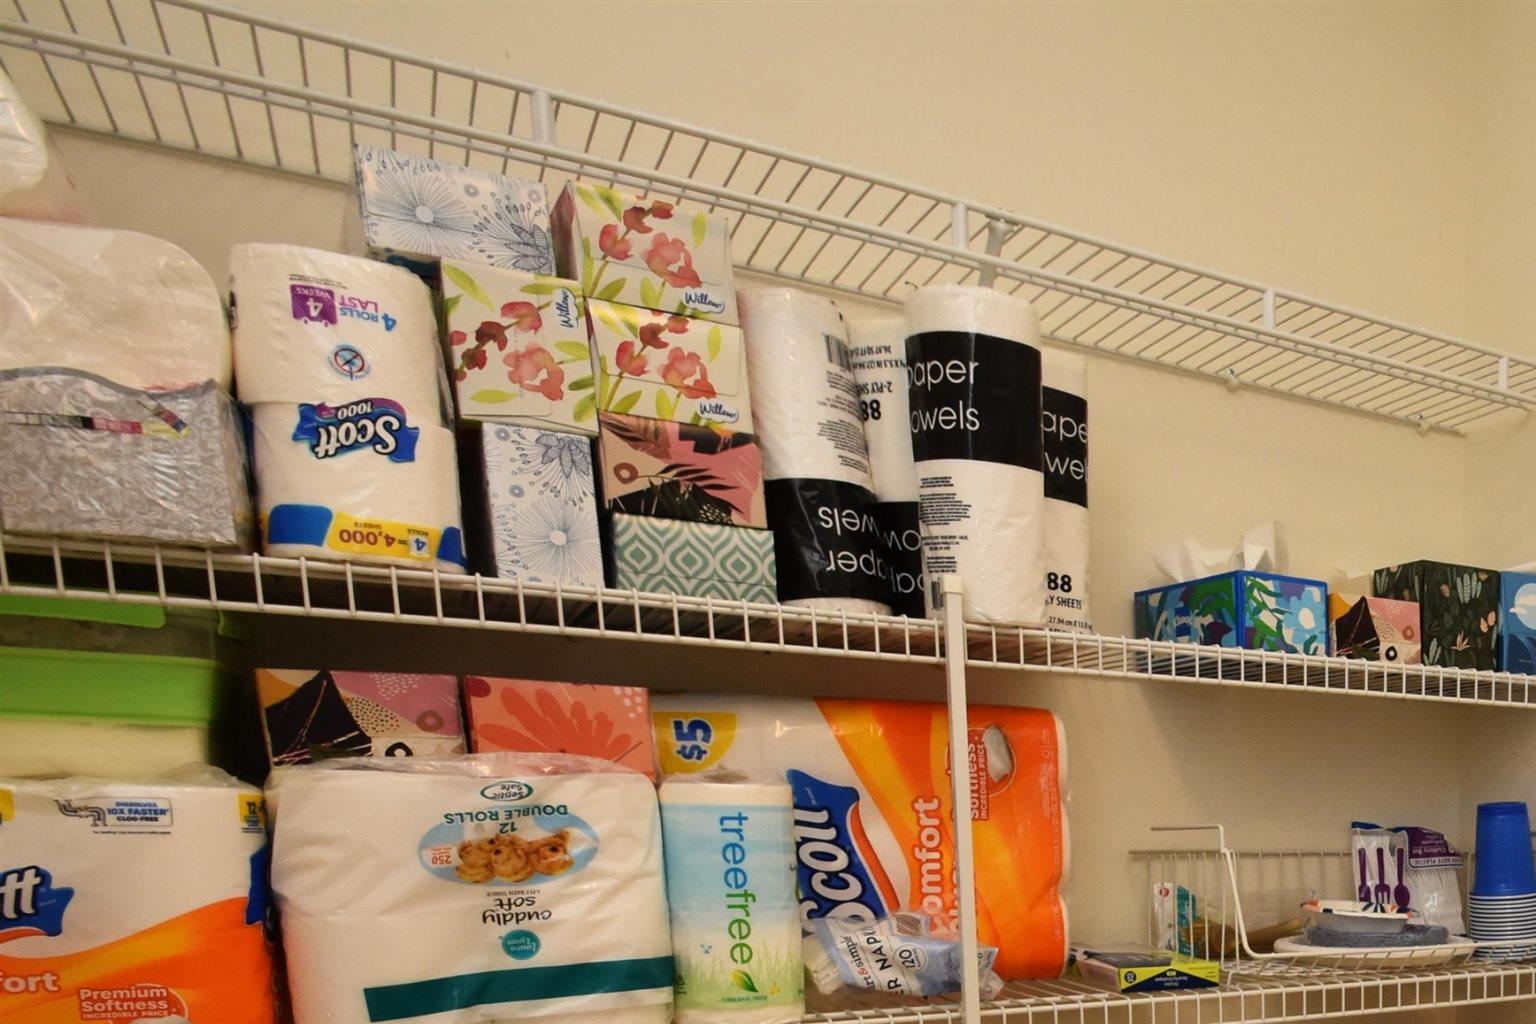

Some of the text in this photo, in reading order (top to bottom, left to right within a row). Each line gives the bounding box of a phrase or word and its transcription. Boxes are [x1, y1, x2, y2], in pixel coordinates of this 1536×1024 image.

[296, 287, 332, 299] WEEKS
[307, 298, 323, 317] 4
[339, 295, 379, 312] LAST
[339, 307, 397, 331] 4 ROLLS
[337, 402, 373, 420] 1000
[861, 399, 882, 421] 88
[911, 400, 980, 433] owels
[315, 414, 400, 458] Scott
[1042, 411, 1088, 443] ape
[1044, 452, 1088, 482] wel
[817, 505, 880, 538] wels
[338, 528, 426, 551] 4 4,000
[826, 549, 889, 579] aper
[1047, 572, 1072, 593] 88
[1056, 596, 1082, 609] SHEETS
[673, 718, 714, 763] $5
[492, 791, 525, 800] Septic
[500, 783, 523, 791] Safe
[979, 779, 988, 820] INCREDIBLE
[107, 808, 125, 816] 10X
[444, 804, 568, 825] DOUBLE ROLLS
[499, 821, 518, 834] 12
[431, 854, 452, 865] 250
[718, 812, 756, 965] treefree
[494, 896, 536, 911] soft
[482, 909, 552, 925] cuddly
[80, 986, 168, 1000] Premium
[81, 999, 168, 1013] Softness
[83, 1011, 138, 1020] INCREDIBLE
